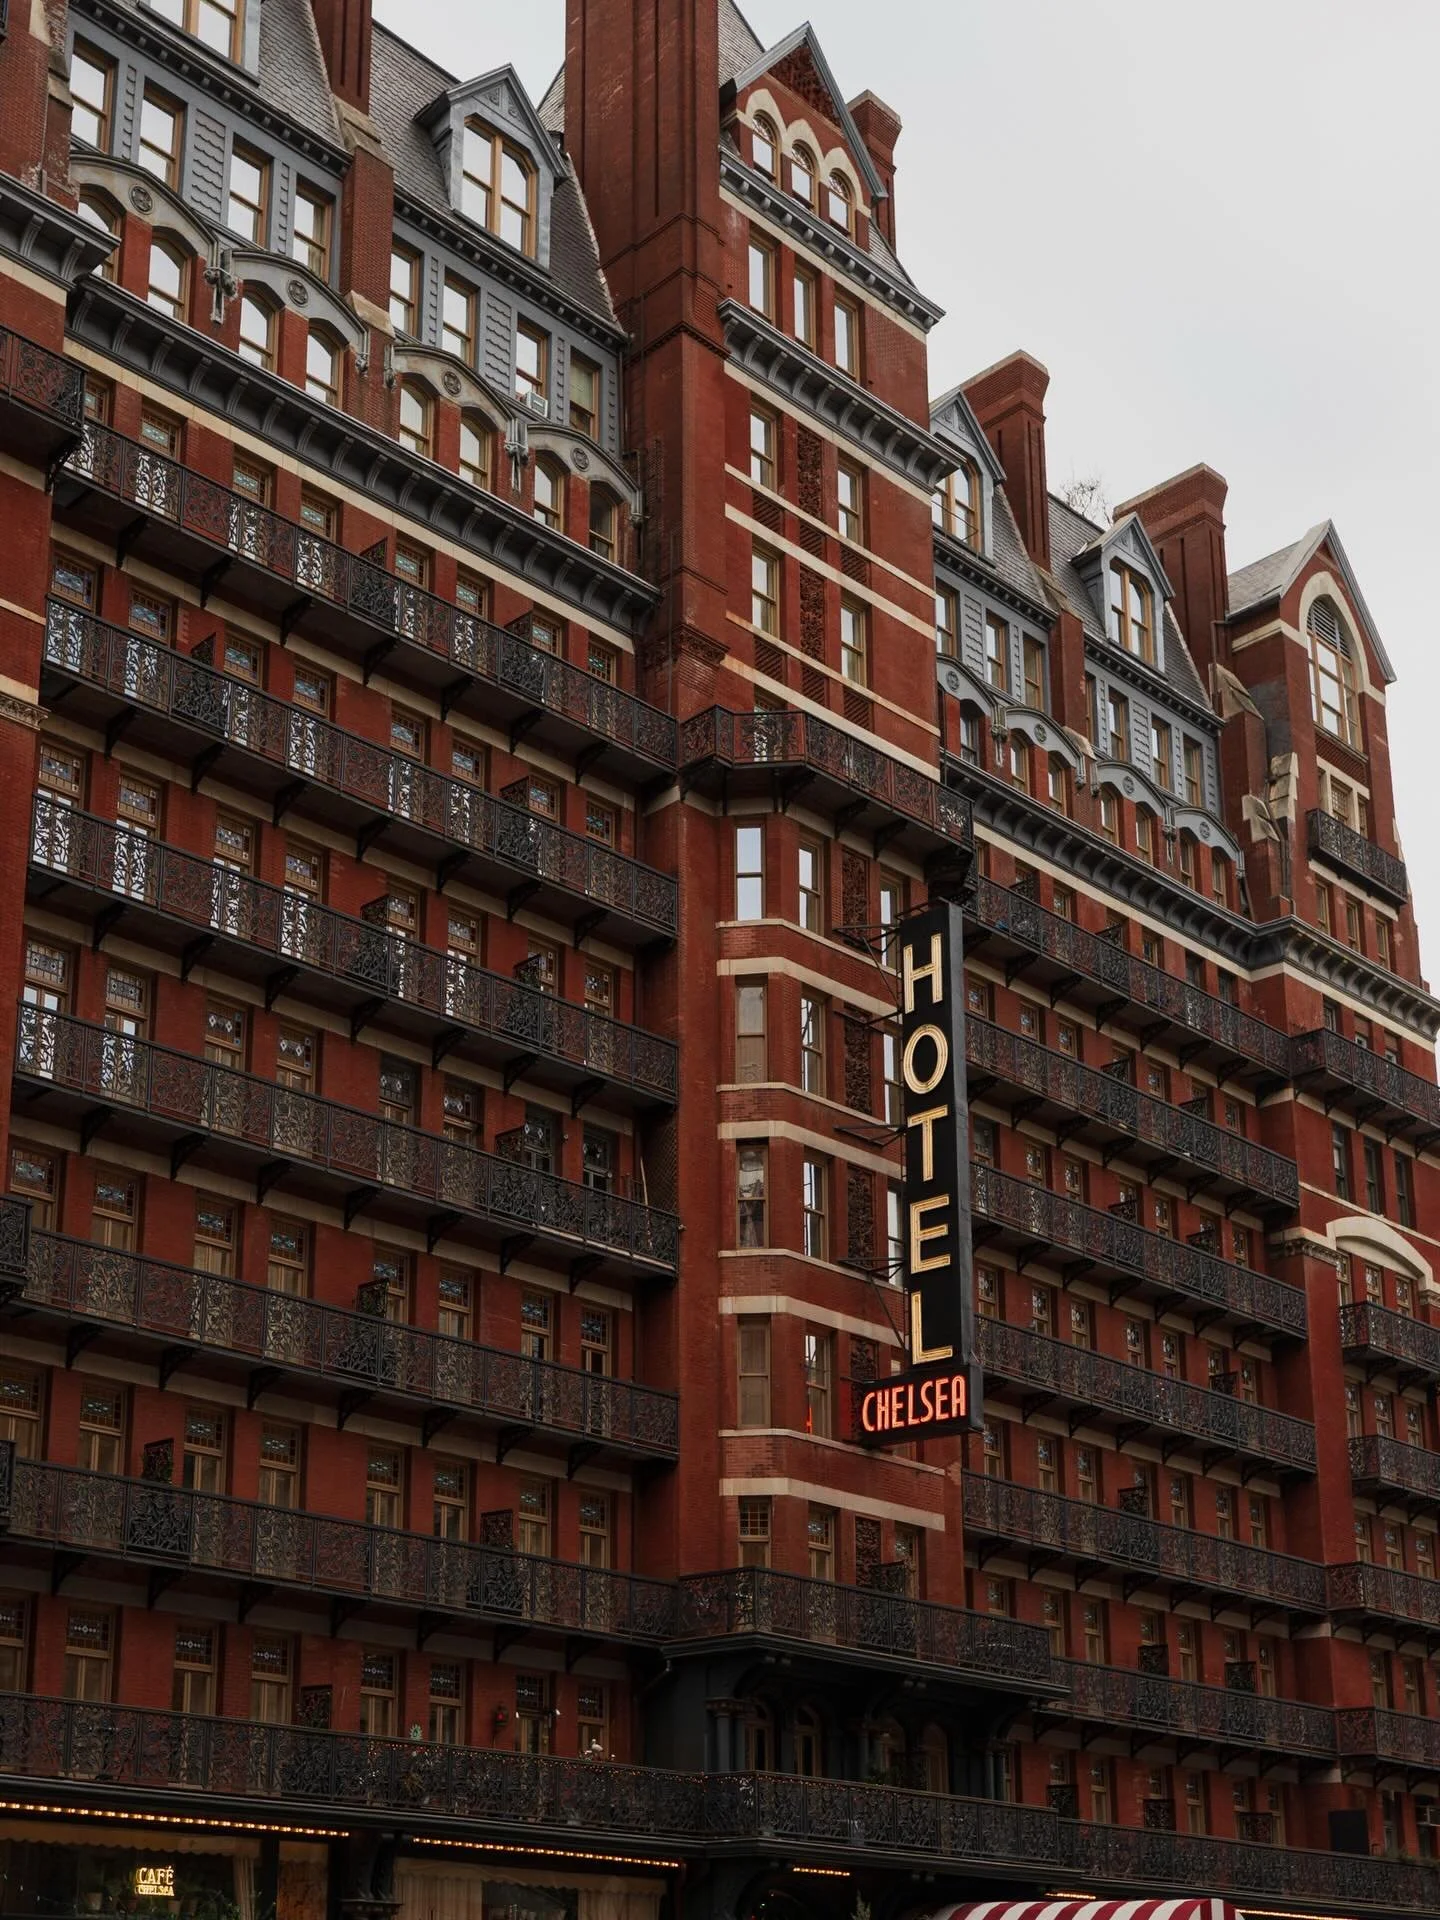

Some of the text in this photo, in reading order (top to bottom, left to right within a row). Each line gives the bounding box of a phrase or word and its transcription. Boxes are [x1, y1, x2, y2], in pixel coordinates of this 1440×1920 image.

[904, 933, 953, 1365] HOTEL
[862, 1375, 966, 1432] CHELSEA
[137, 1885, 175, 1897] CHELSEA
[138, 1865, 175, 1885] CAFÉ
